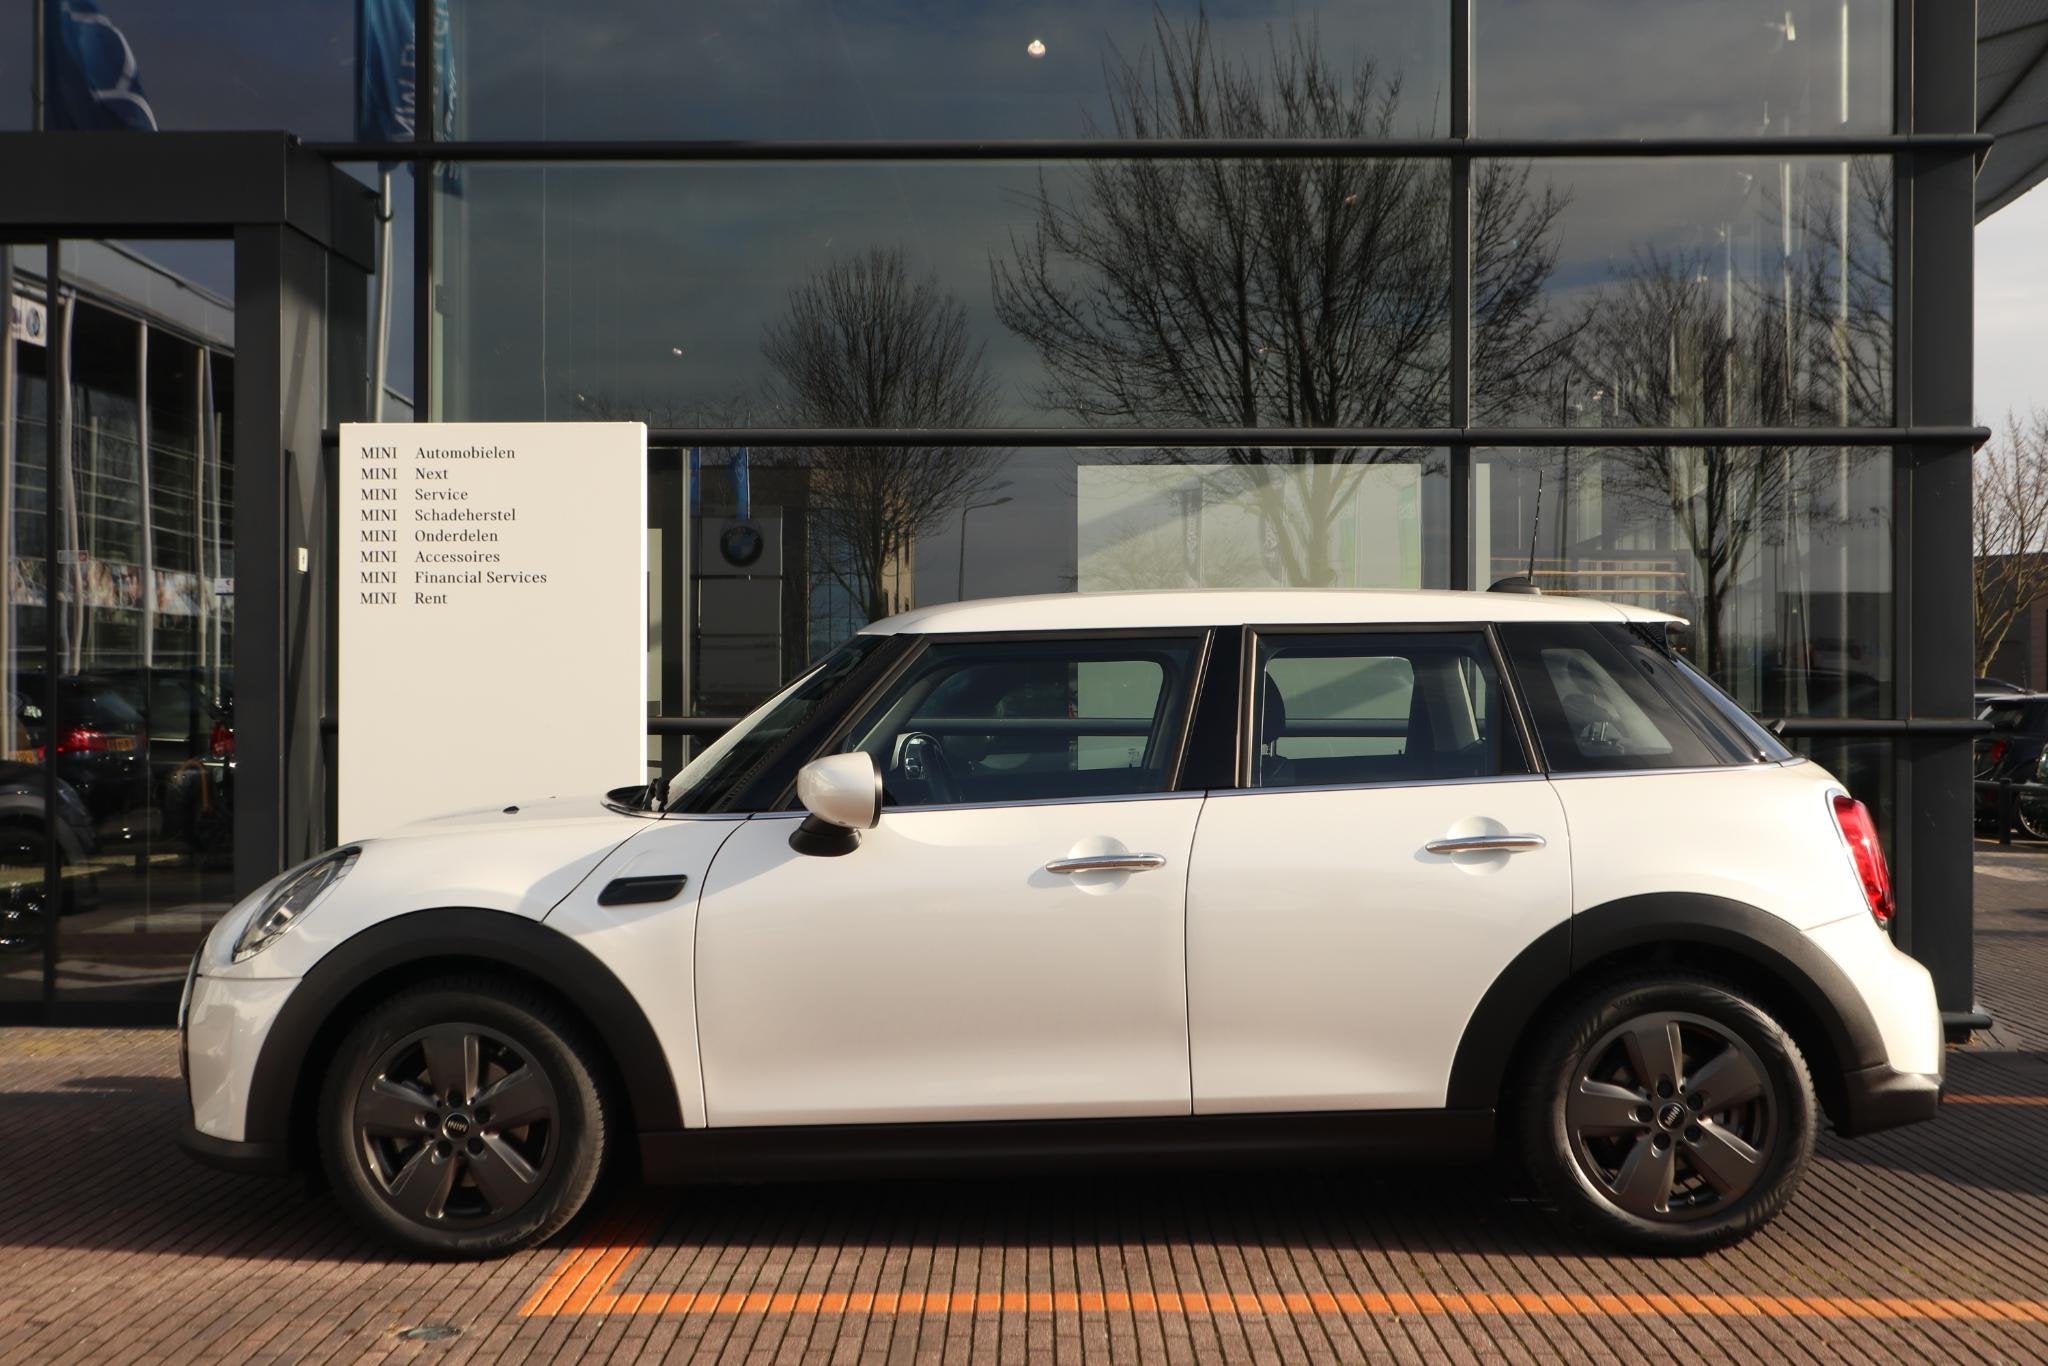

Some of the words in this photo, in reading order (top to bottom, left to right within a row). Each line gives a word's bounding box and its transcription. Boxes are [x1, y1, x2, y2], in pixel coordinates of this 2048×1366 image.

[361, 447, 397, 459] MINI
[416, 446, 514, 459] Automobielen
[361, 468, 397, 480] MINI
[416, 468, 448, 480] Next
[361, 488, 397, 500] MINI
[415, 488, 468, 500] Service
[361, 509, 397, 521] MINI
[415, 508, 515, 521] Schadeherstel
[361, 530, 397, 542] MINI
[415, 529, 497, 542] Onderdelen
[361, 550, 397, 562] MINI
[415, 550, 500, 562] Accessoires
[361, 571, 397, 583] MINI
[415, 571, 481, 583] Financial
[487, 571, 547, 583] Services
[361, 592, 397, 604] MINI
[415, 592, 447, 604] Rent
[1664, 1106, 1680, 1127] MINI
